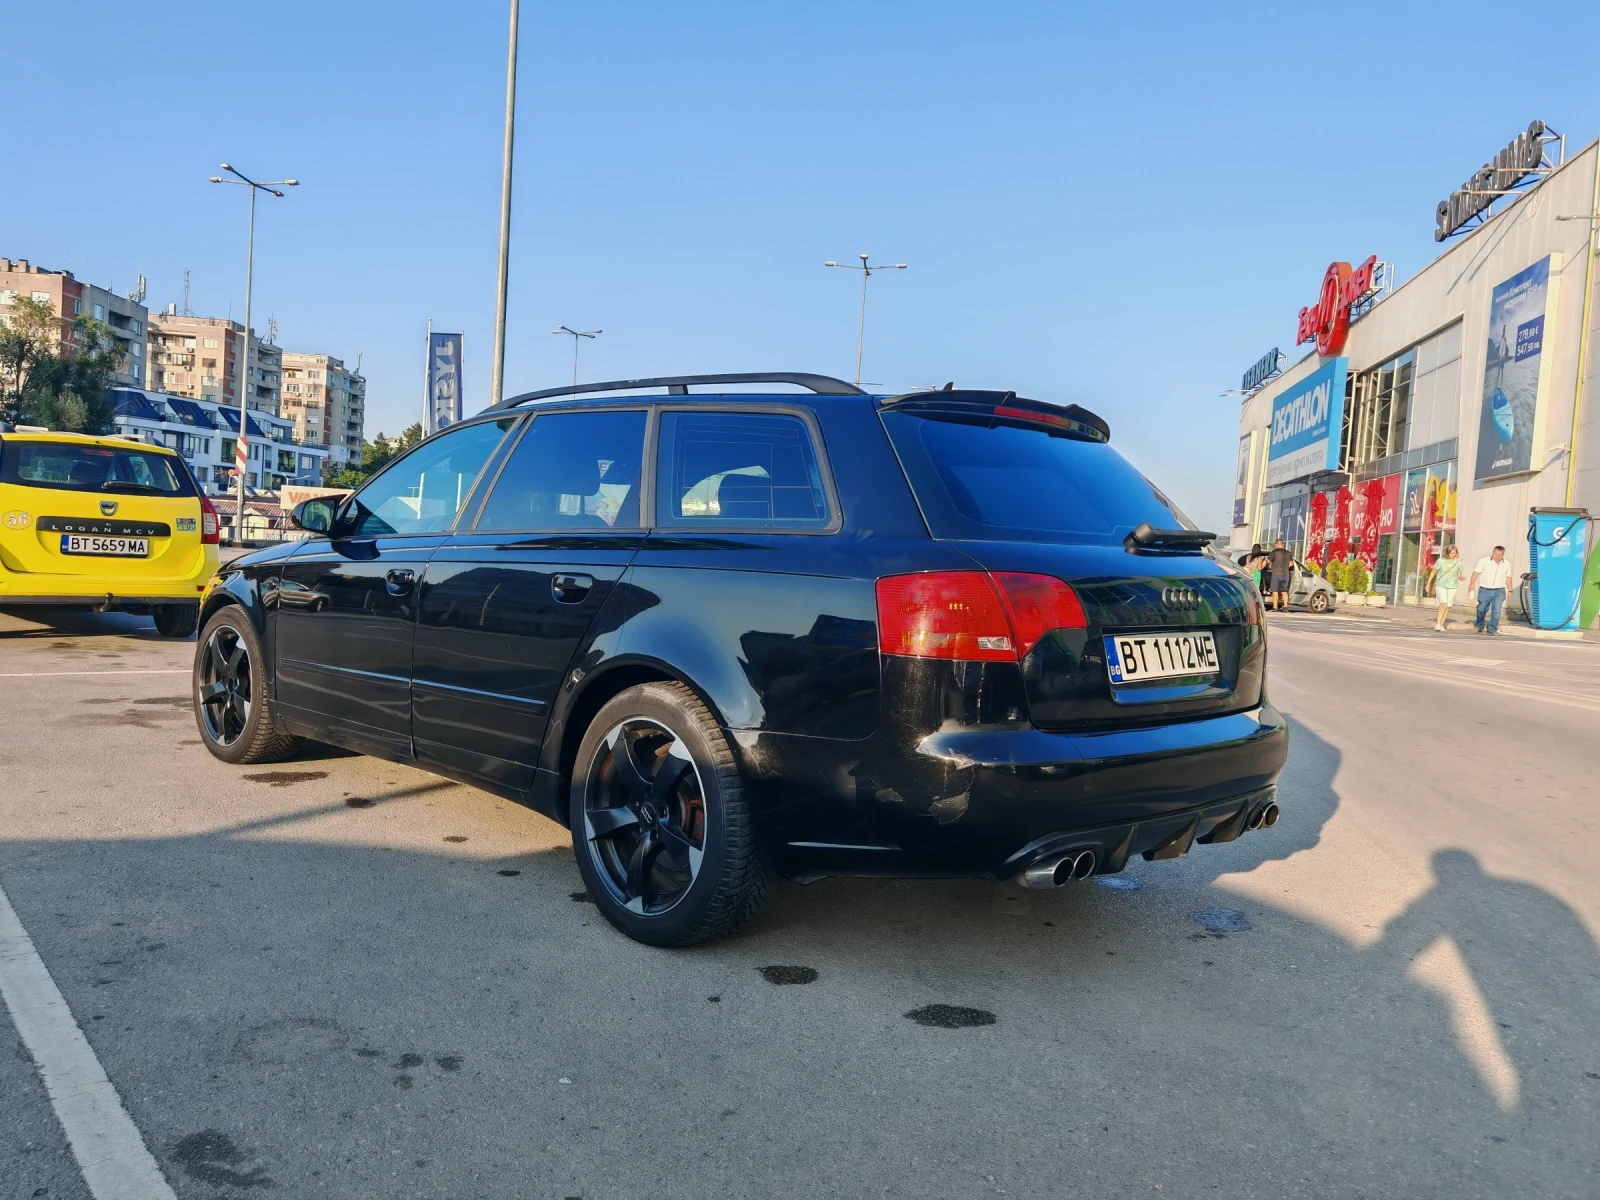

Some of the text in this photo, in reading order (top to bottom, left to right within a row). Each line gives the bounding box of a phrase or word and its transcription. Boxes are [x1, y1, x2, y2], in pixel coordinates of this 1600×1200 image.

[1272, 379, 1331, 446] DECATHLON
[8, 513, 28, 526] 56
[52, 525, 111, 533] LOGAN
[92, 539, 125, 552] 5659
[1153, 637, 1196, 671] 1112
[1110, 665, 1121, 675] BG
